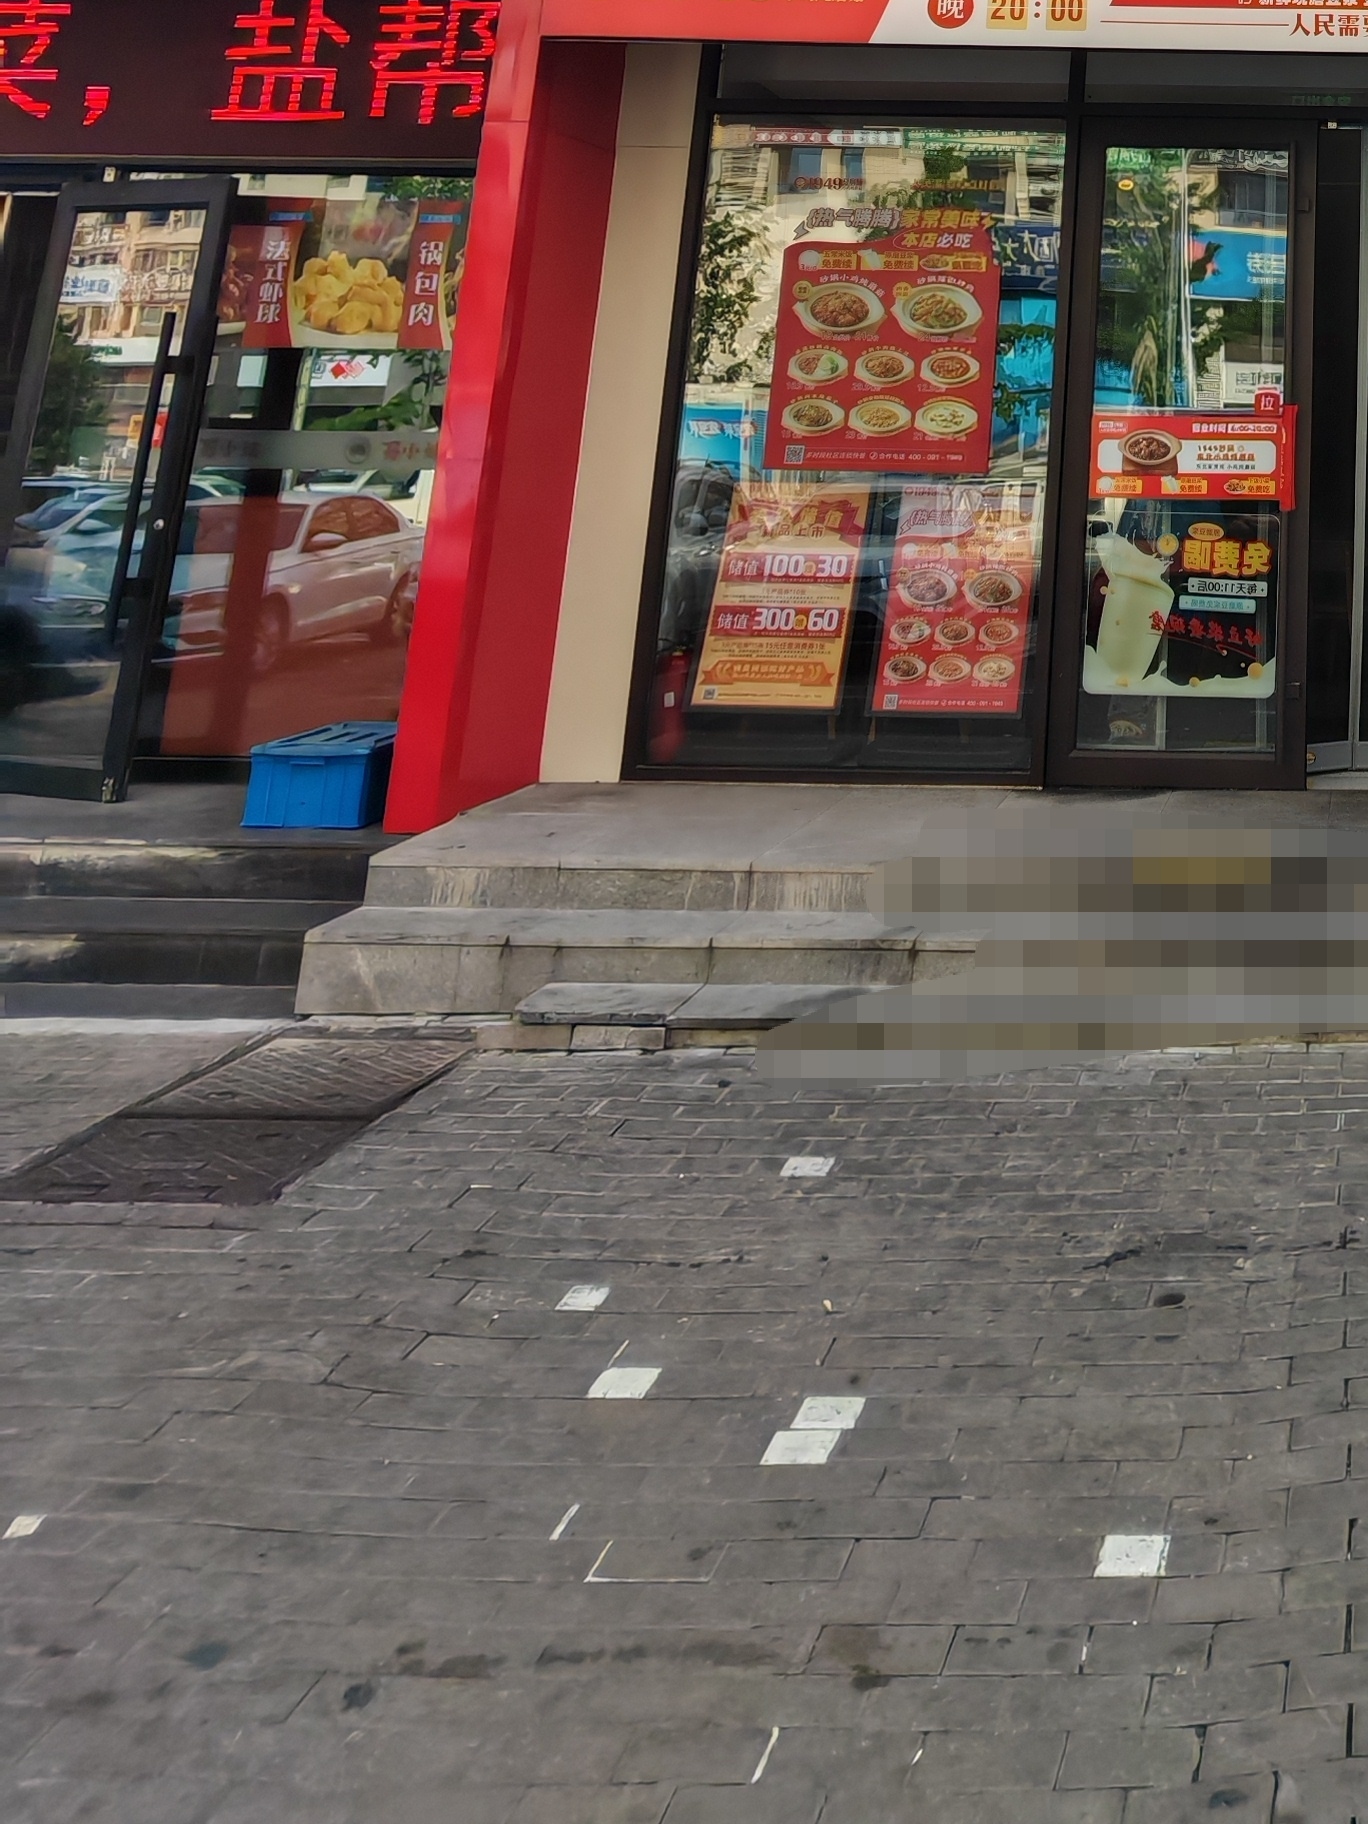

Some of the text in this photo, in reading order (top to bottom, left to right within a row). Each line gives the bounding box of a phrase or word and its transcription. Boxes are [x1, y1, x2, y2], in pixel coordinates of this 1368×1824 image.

[254, 239, 292, 325] 法式虾球
[407, 240, 445, 327] 锅包肉
[901, 232, 974, 249] 本店必吃
